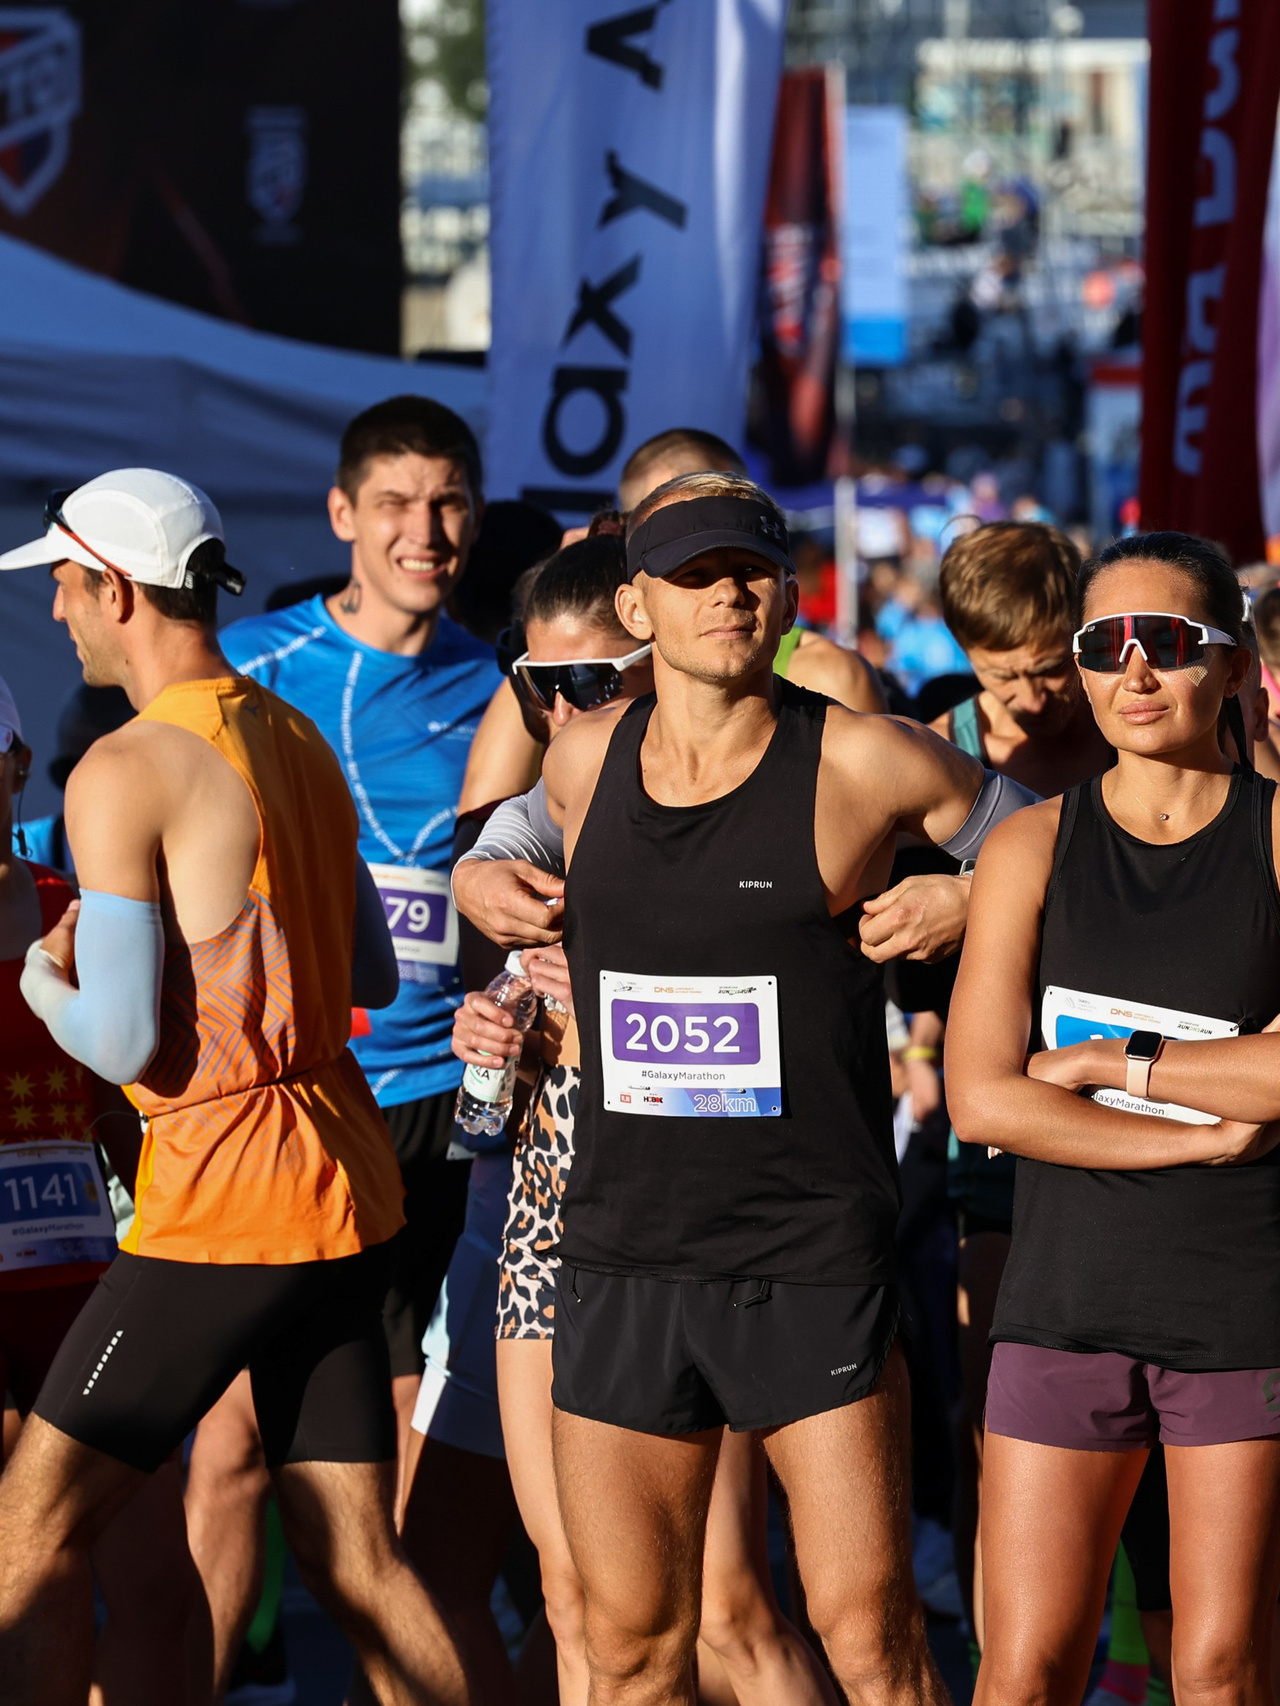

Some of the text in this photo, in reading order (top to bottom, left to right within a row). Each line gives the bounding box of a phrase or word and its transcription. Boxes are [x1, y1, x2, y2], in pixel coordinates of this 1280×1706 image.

[738, 880, 773, 889] KIPRUN
[381, 896, 431, 933] 79
[654, 986, 675, 994] DNS
[1110, 1008, 1134, 1018] DNS
[625, 1012, 741, 1054] 2052
[641, 1070, 726, 1081] #GalaxyMarathon
[693, 1093, 757, 1112] 28km
[4, 1173, 78, 1211] 1141
[830, 1362, 858, 1376] KIPRUN
